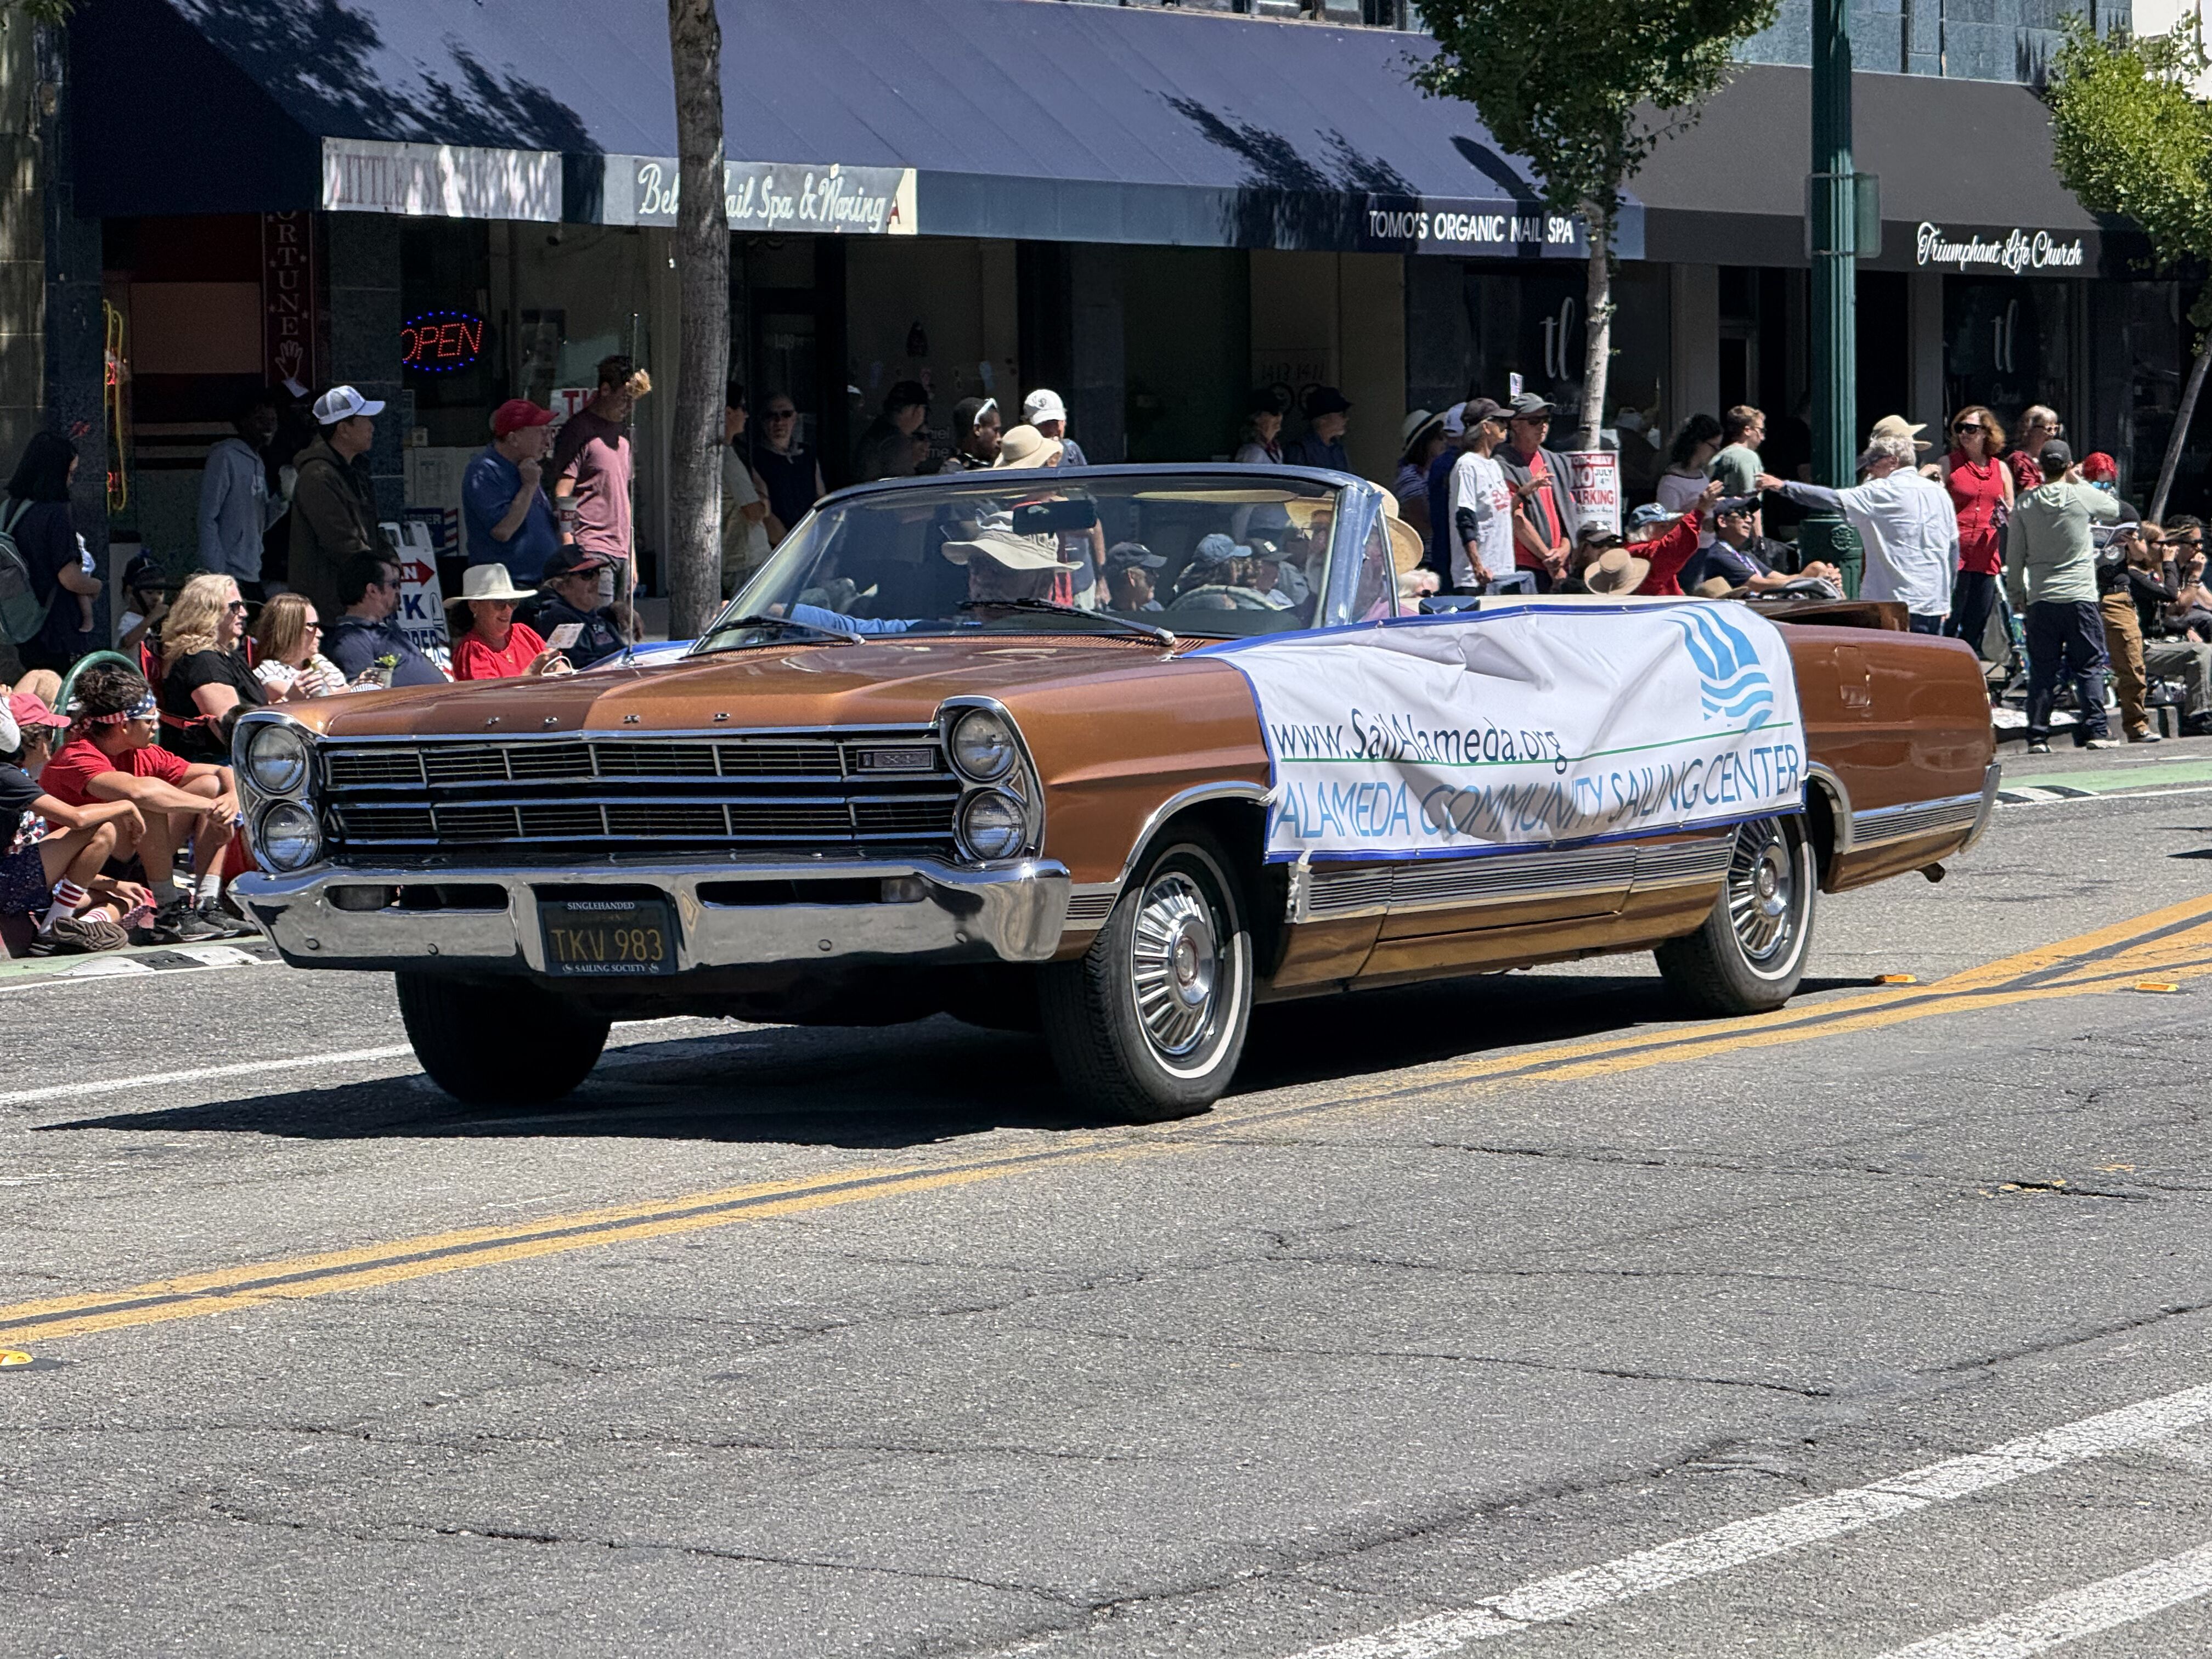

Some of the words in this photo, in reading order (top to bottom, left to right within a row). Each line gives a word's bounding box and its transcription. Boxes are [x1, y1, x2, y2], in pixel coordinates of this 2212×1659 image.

[638, 163, 680, 215] Bel
[757, 175, 794, 228] Spa
[799, 172, 816, 219] &
[818, 176, 887, 233] Waxing
[1369, 211, 1428, 240] TOMO'S
[1434, 212, 1505, 242] ORGANIC
[1510, 216, 1542, 242] NAIL
[1547, 217, 1575, 244] SPA
[1917, 222, 2004, 271] Triumphant
[2002, 228, 2031, 274] Life
[2032, 231, 2083, 268] Church
[276, 212, 299, 336] RTUNE
[399, 320, 481, 360] OPEN
[1571, 467, 1593, 487] NO
[1572, 455, 1613, 466] OW-AWAY
[1576, 489, 1614, 505] ARKING
[1271, 708, 1567, 775] www.SailAlameda.org
[1271, 782, 1410, 838] ALAMEDA
[1420, 775, 1603, 836] COMMUNITY
[1608, 758, 1703, 823] SAILING
[1703, 744, 1799, 805] CENTER
[567, 902, 635, 911] SINGLEHANDED
[551, 929, 605, 962] TKV
[614, 928, 663, 962] 983
[575, 964, 610, 973] SAILING
[611, 964, 645, 973] SOCIETY
